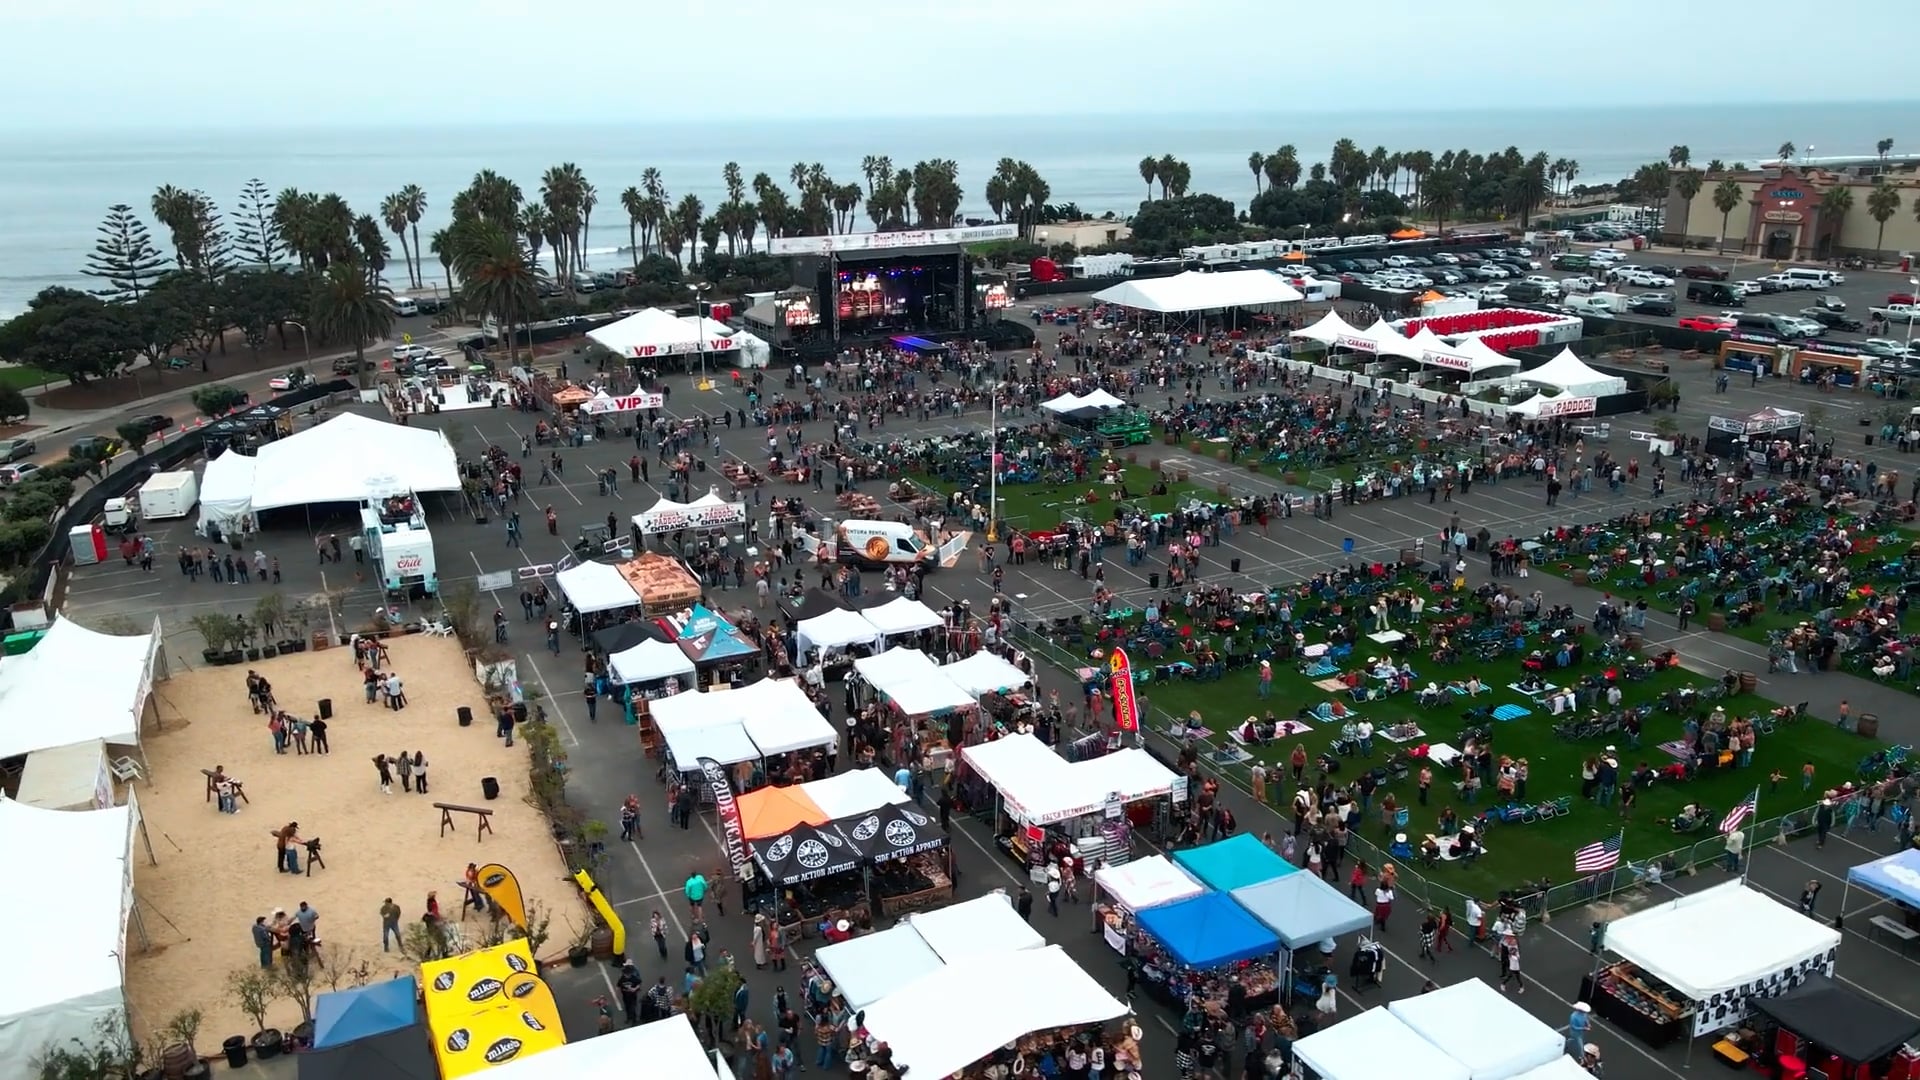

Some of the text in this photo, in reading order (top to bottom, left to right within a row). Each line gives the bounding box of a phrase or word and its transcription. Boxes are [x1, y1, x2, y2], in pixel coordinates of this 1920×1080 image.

[711, 339, 732, 349] VIP
[1347, 339, 1375, 350] CABANAS
[634, 345, 657, 356] VIP
[1435, 356, 1469, 368] CABANAS
[615, 397, 642, 410] VIP
[700, 516, 738, 526] ENTRANCE
[650, 522, 689, 532] ENTRANCE
[397, 558, 422, 568] Chill
[875, 853, 890, 864] SIDE
[891, 846, 915, 859] ACTION
[783, 875, 800, 885] SIDE
[801, 867, 826, 881] ACTION
